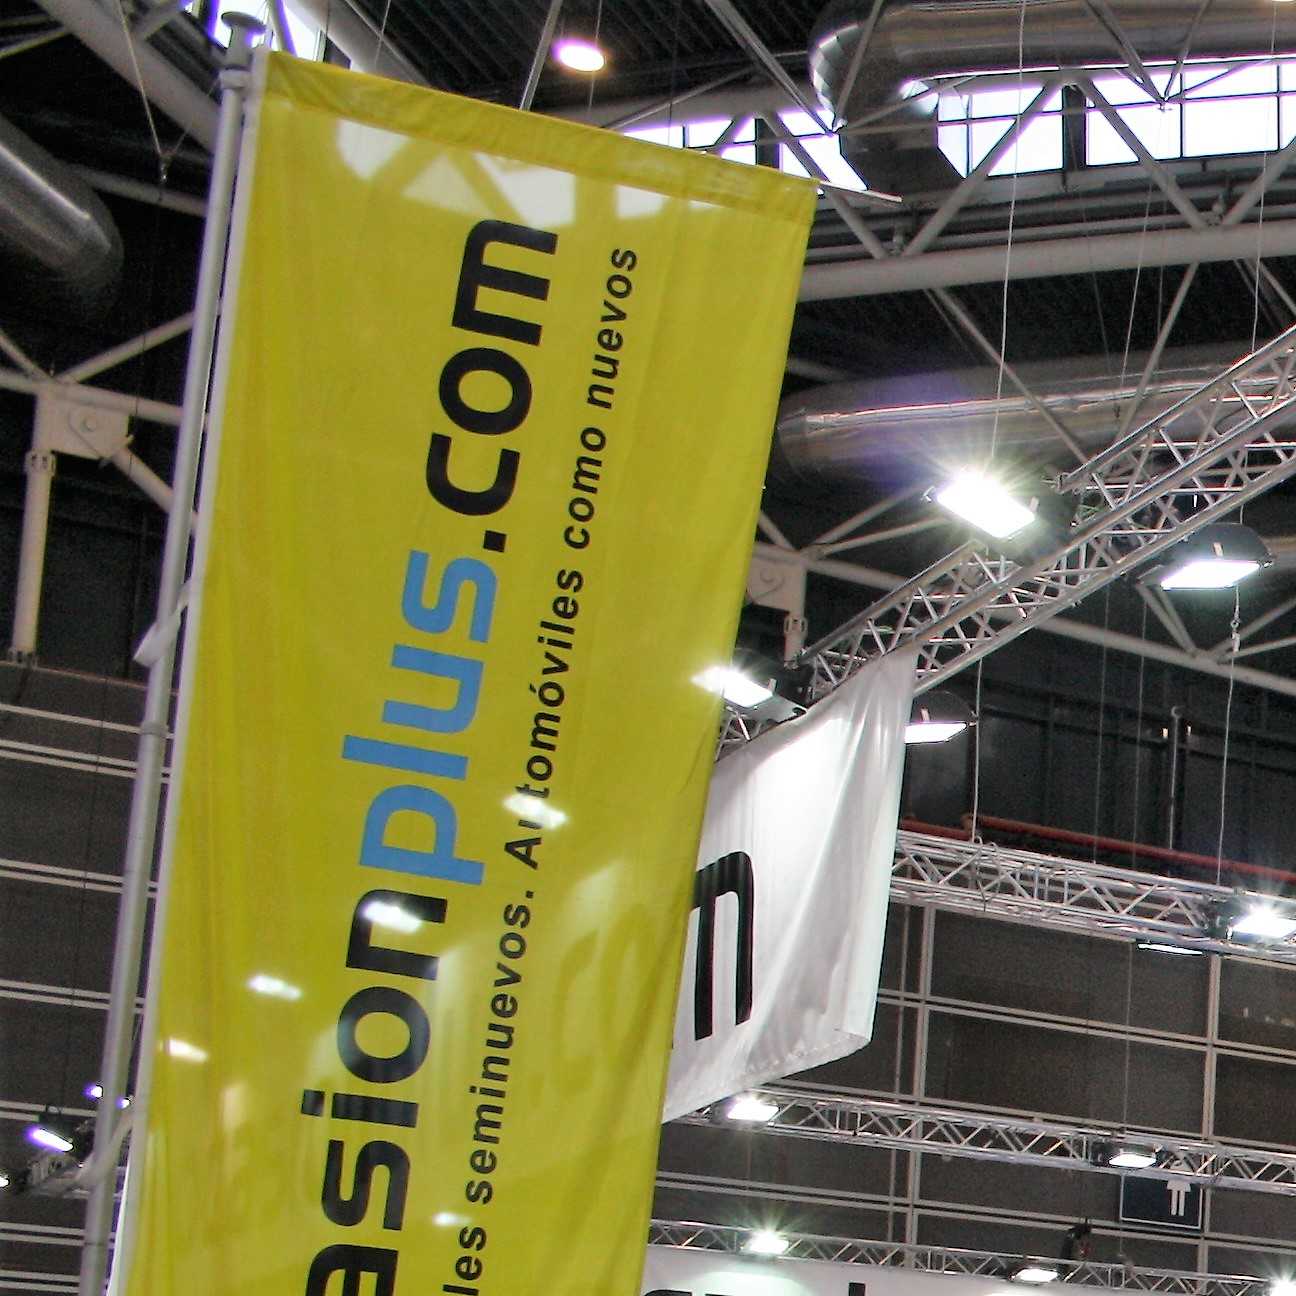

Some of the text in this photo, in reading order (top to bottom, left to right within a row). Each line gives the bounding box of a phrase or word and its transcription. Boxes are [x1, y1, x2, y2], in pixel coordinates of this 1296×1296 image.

[466, 890, 535, 1203] seminuevos.
[564, 427, 607, 551] como
[586, 246, 638, 410] nuevos
